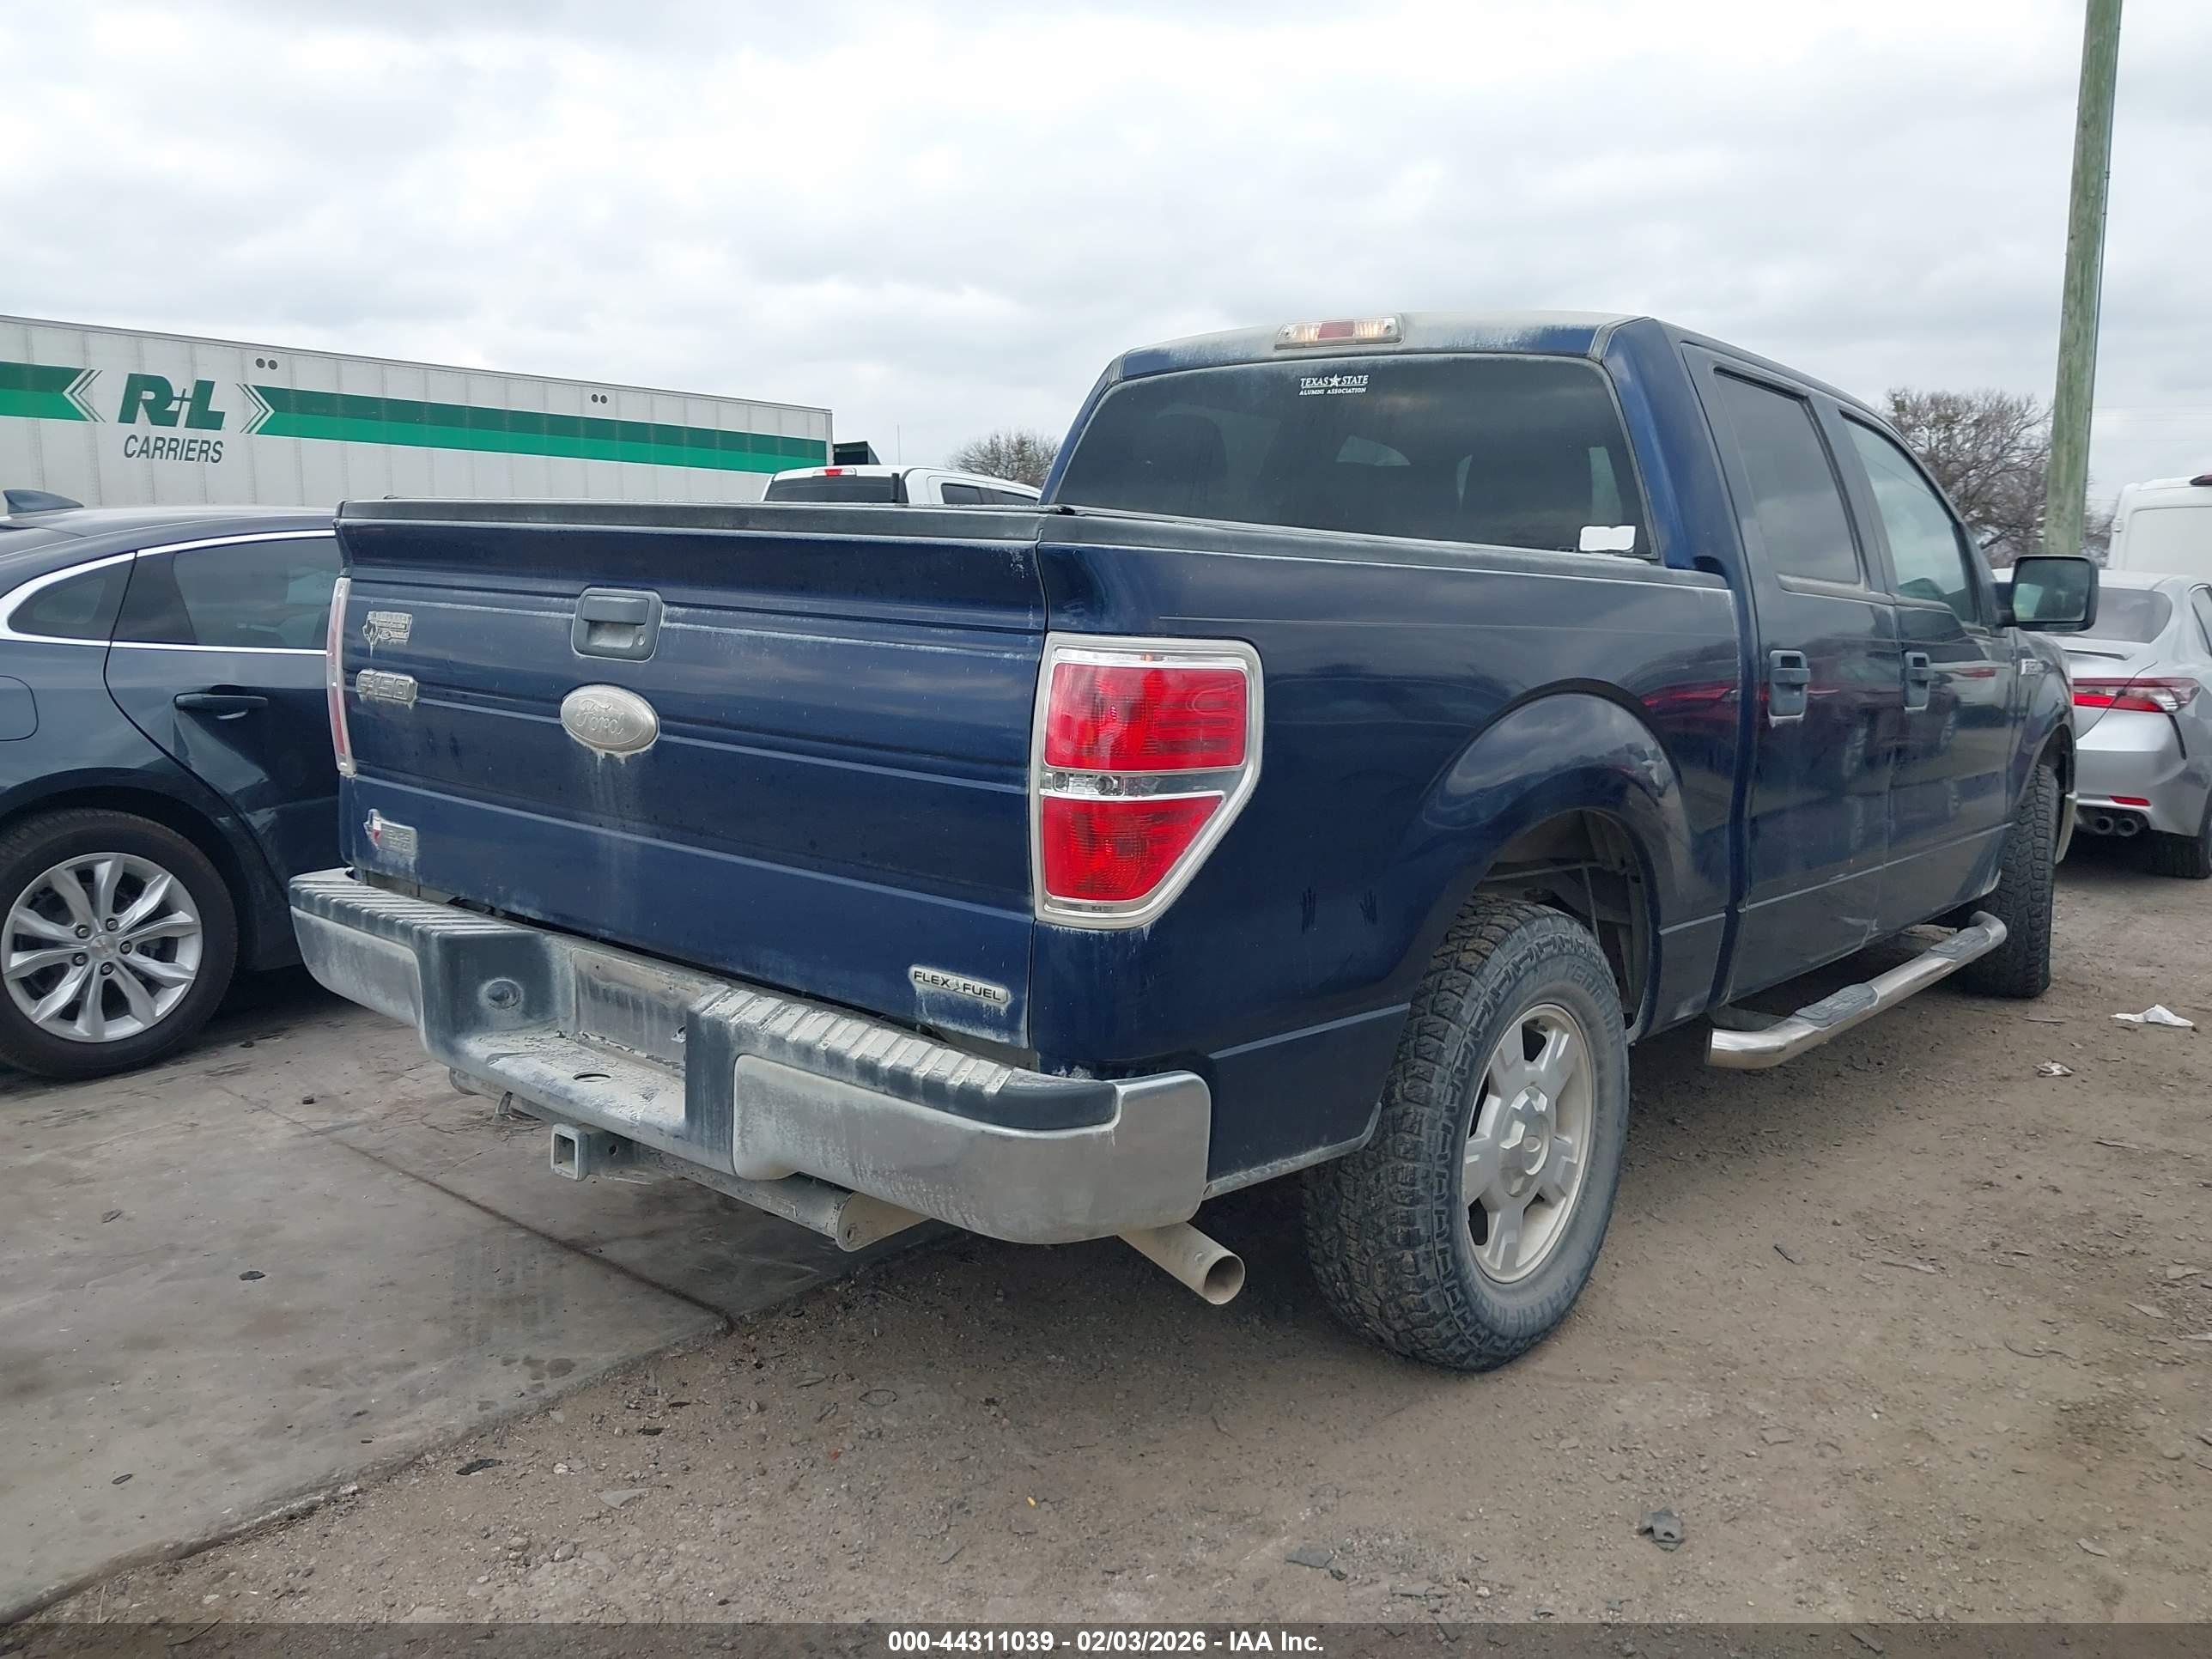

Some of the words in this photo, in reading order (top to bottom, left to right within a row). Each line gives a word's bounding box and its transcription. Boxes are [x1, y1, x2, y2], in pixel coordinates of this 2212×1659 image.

[1300, 376, 1329, 387] TEXAS
[1341, 374, 1369, 385] STATE
[124, 434, 223, 464] CARRIERS
[575, 698, 625, 735] Ford
[914, 970, 951, 988] FLEX
[963, 982, 1001, 1000] FUEL
